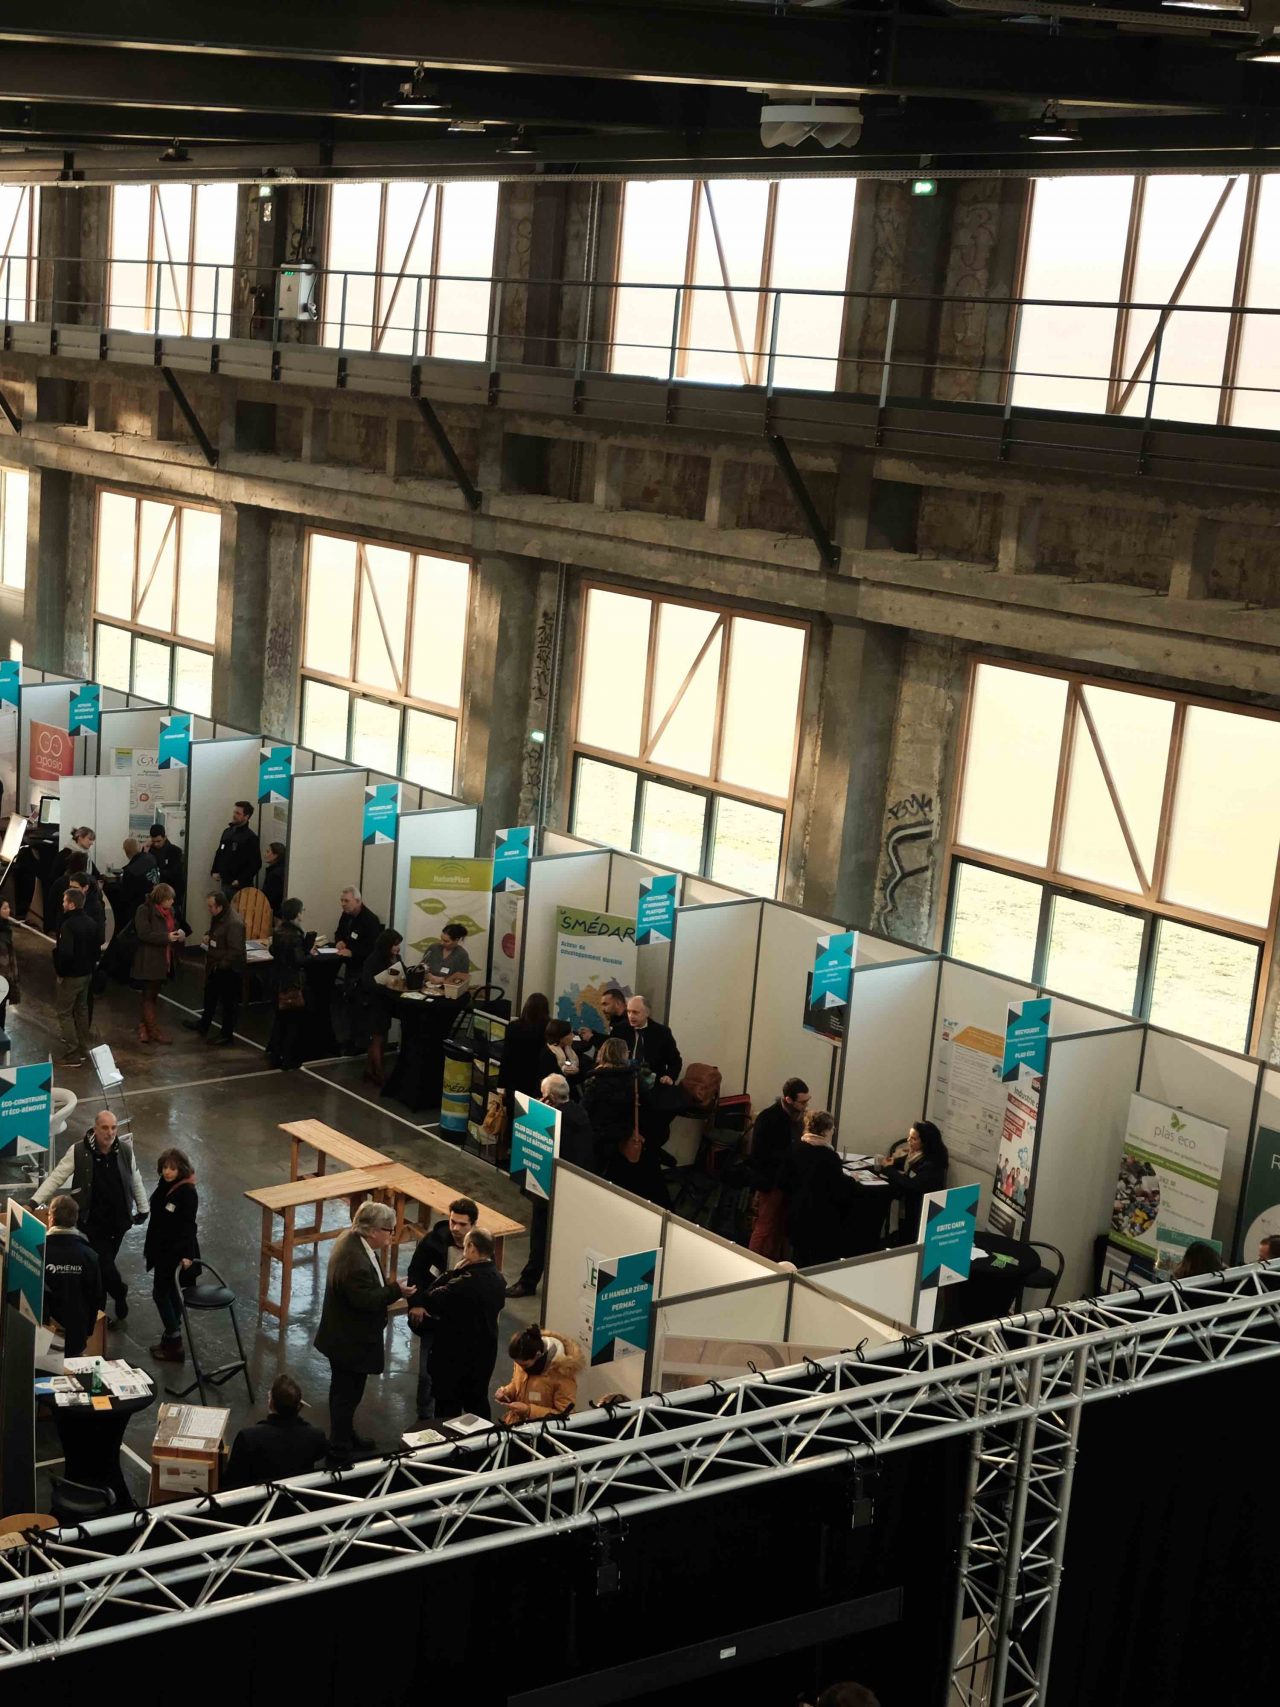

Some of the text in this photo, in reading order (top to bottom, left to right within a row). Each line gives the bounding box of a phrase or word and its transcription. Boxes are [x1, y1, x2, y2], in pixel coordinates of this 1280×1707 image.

[561, 915, 637, 944] SMÉDAR
[1, 1094, 48, 1108] ÉCO-CONSTRUIRE
[9, 1103, 47, 1115] ÉCO-RÉNOVER
[56, 1263, 83, 1272] PHENIX
[601, 1283, 649, 1301] LE HANGAR ZÉRO
[611, 1299, 637, 1311] PERMAC
